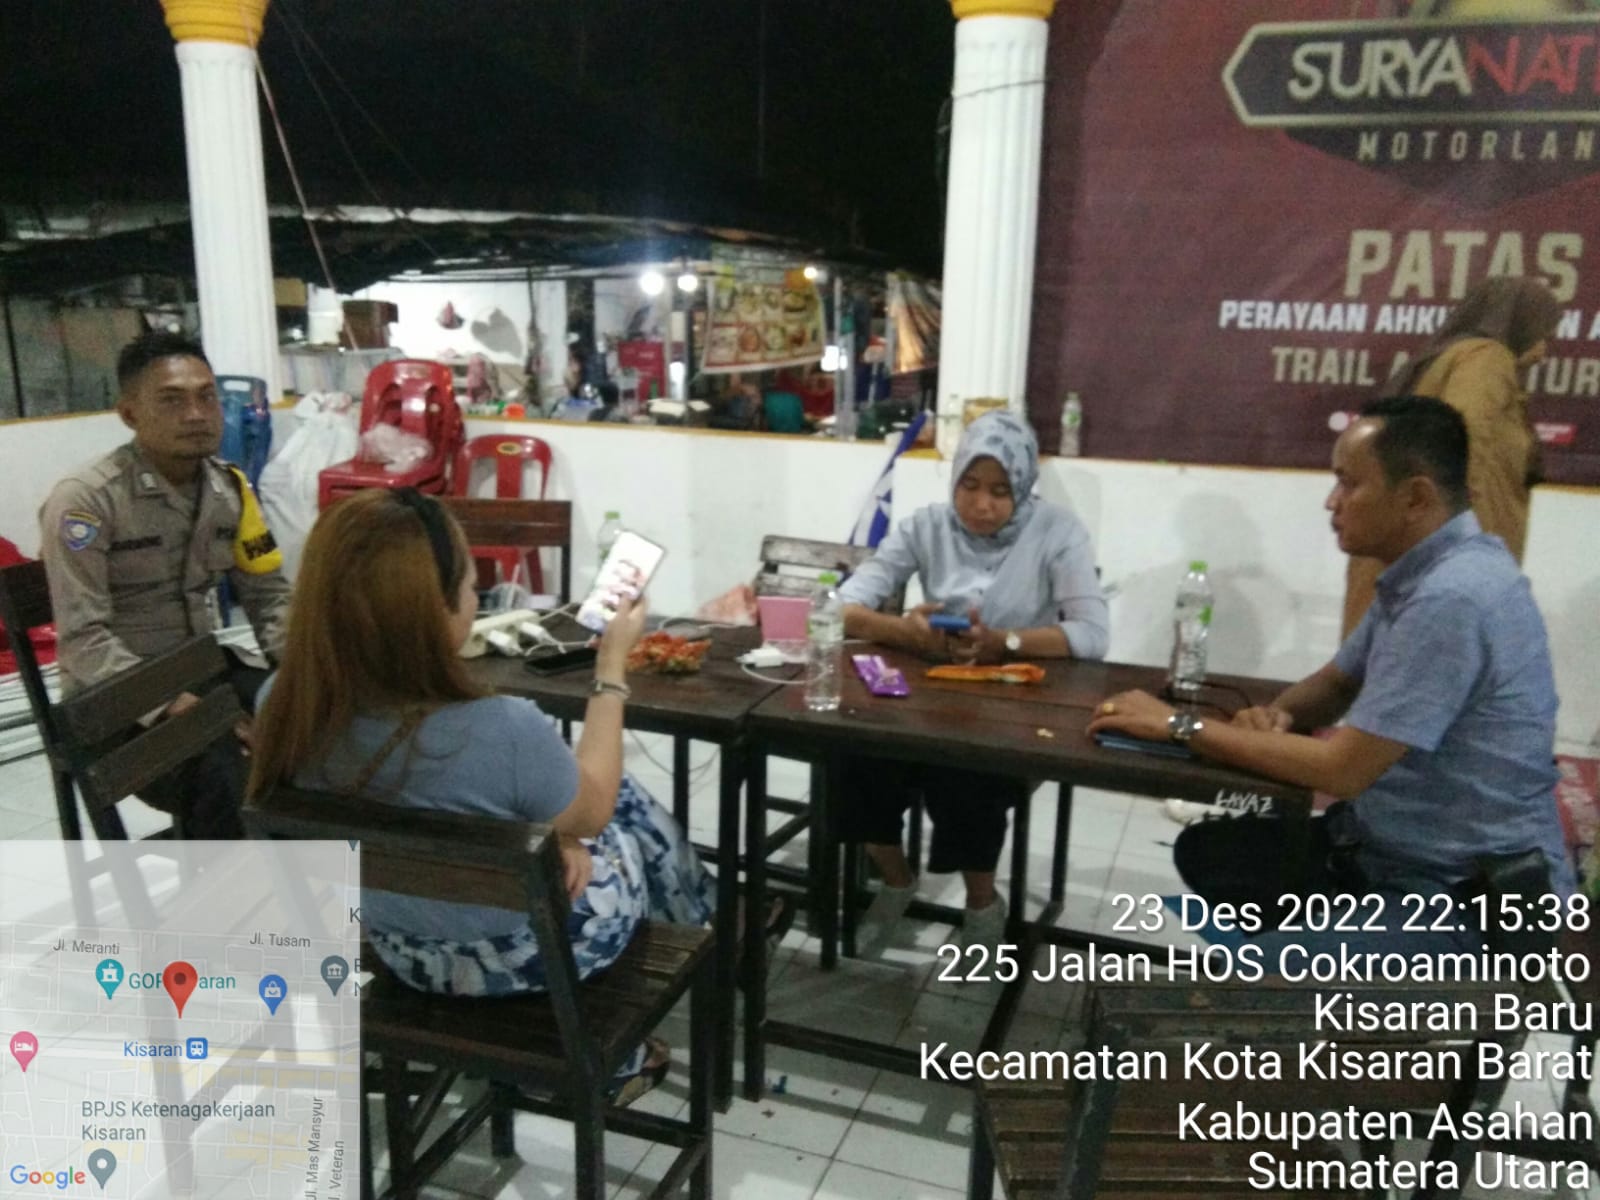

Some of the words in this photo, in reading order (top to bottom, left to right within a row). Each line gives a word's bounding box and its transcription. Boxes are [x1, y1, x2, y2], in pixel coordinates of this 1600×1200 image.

[1357, 130, 1595, 161] MOTORLAN
[1343, 229, 1584, 304] PATAS
[1218, 300, 1368, 332] PERAYAAN
[1271, 346, 1375, 386] TRAIL
